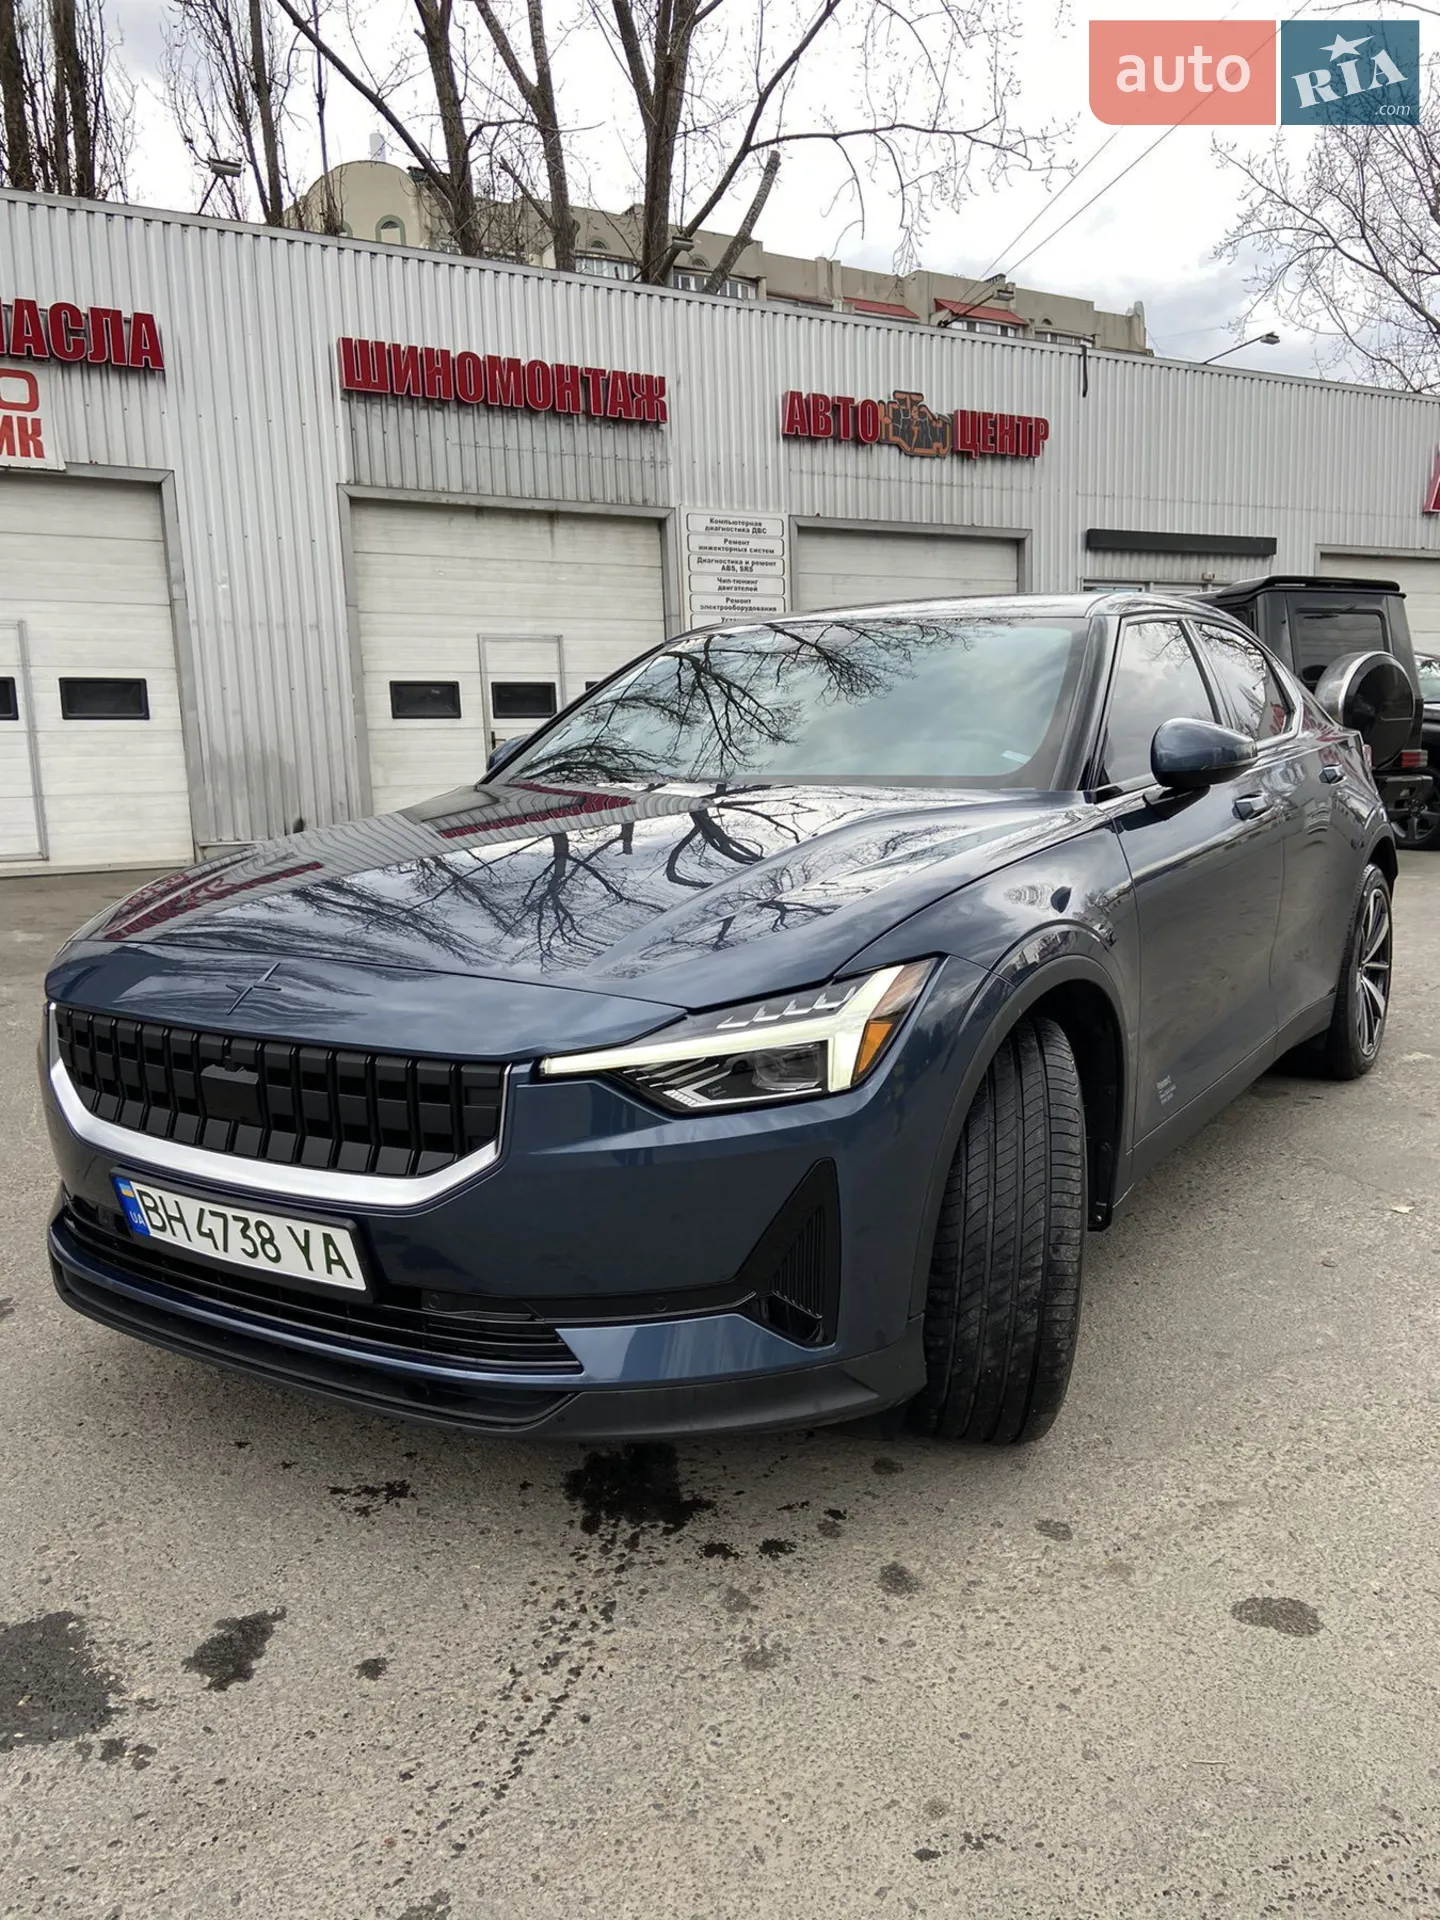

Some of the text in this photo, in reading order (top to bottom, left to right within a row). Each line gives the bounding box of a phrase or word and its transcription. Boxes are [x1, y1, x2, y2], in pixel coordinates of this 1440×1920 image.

[0, 297, 165, 370] АСЛА
[337, 336, 669, 424] ШИНОМОНТАЖ
[782, 389, 880, 444] АВТО
[953, 408, 1050, 459] ЦЕНТР
[696, 557, 743, 565] Диагностика
[723, 538, 750, 546] Ремонт
[130, 1210, 145, 1226] UA
[196, 1207, 282, 1263] 4738
